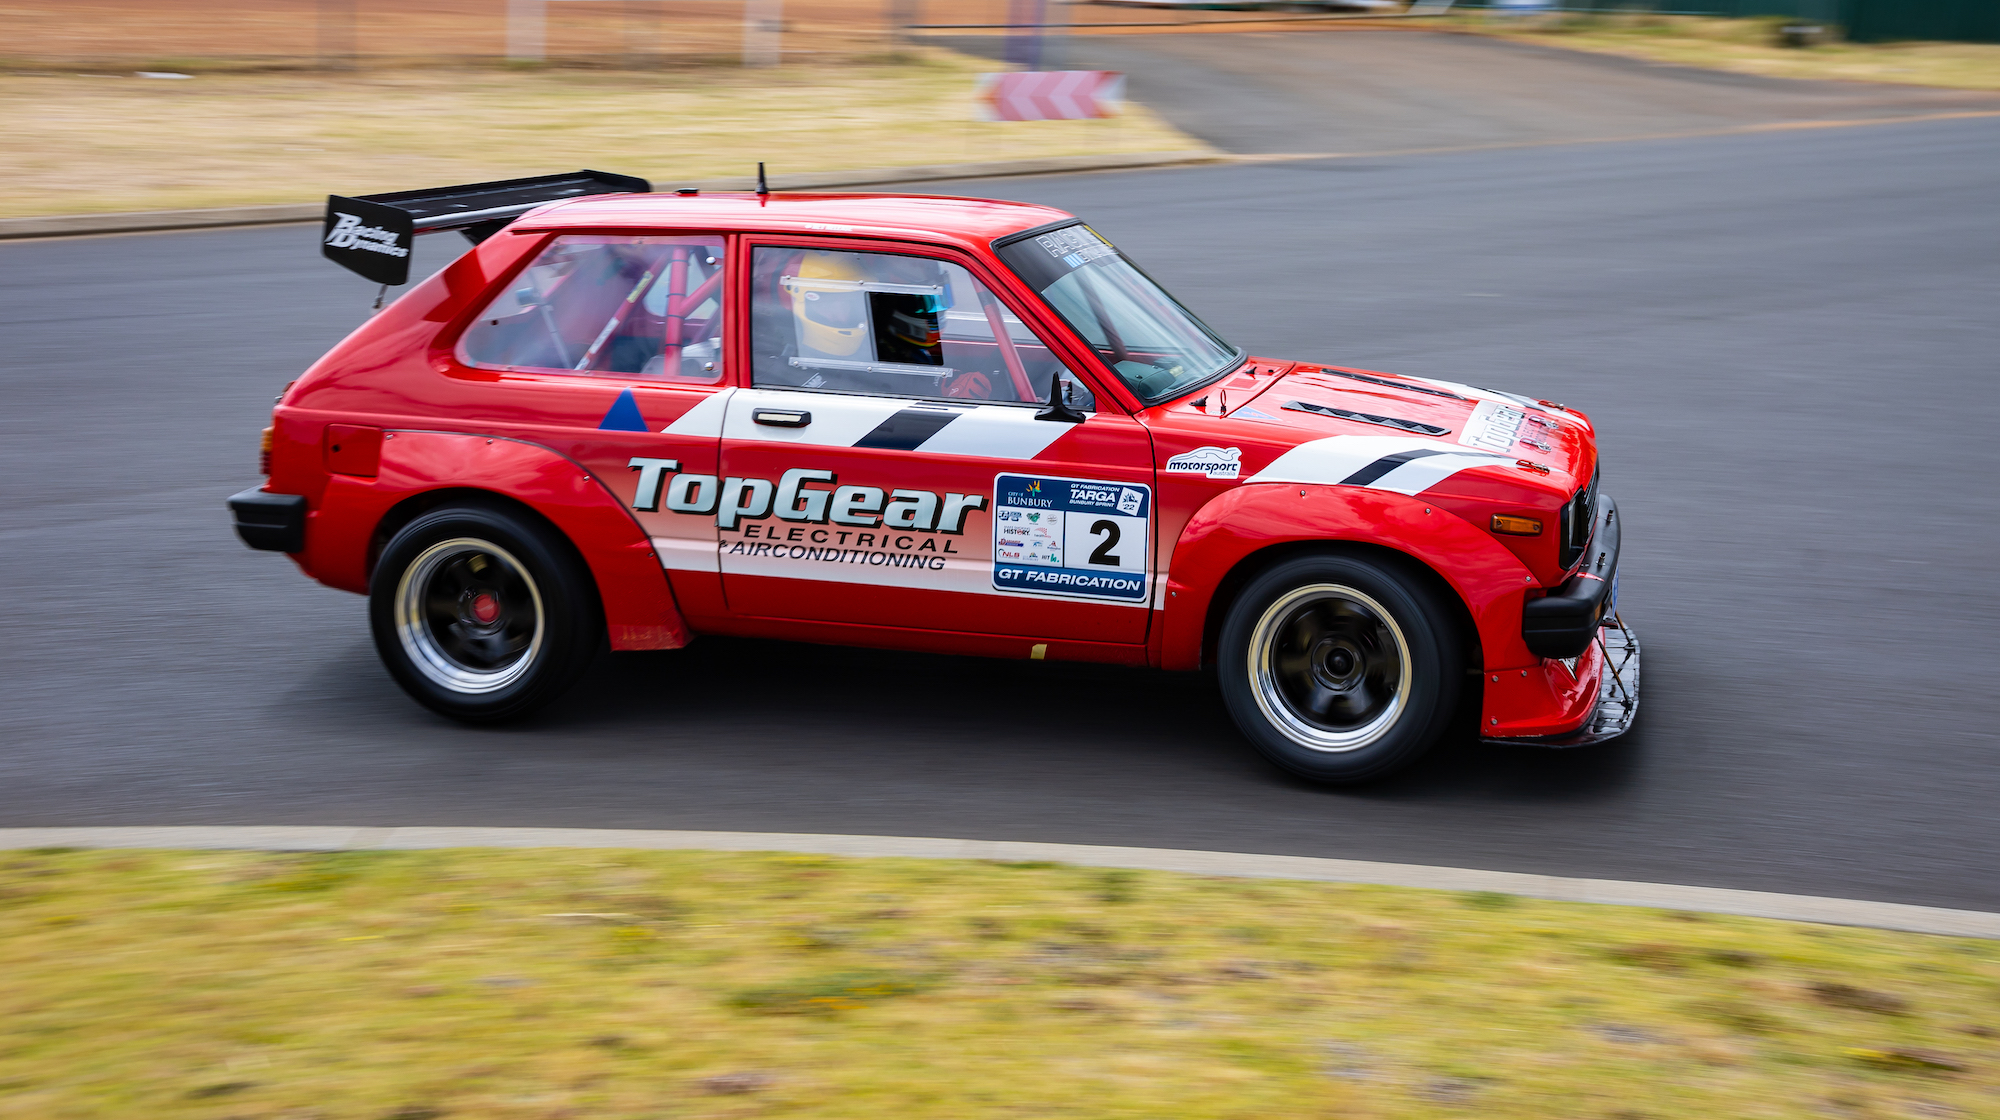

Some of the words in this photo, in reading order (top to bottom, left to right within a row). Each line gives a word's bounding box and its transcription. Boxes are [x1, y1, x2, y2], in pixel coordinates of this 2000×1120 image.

[324, 212, 400, 247] Racing
[325, 233, 409, 257] Dynamics
[1168, 461, 1238, 475] motorsport
[627, 457, 988, 535] TopGear
[1070, 488, 1116, 503] TARGA
[1080, 484, 1120, 492] FABRICATION
[1007, 496, 1053, 508] BUNBURY
[744, 524, 959, 554] ELECTRICAL
[1088, 519, 1121, 567] 2
[729, 541, 947, 571] AIRCONDITIONING
[998, 568, 1023, 580] GT
[1025, 570, 1141, 591] FABRICATION
